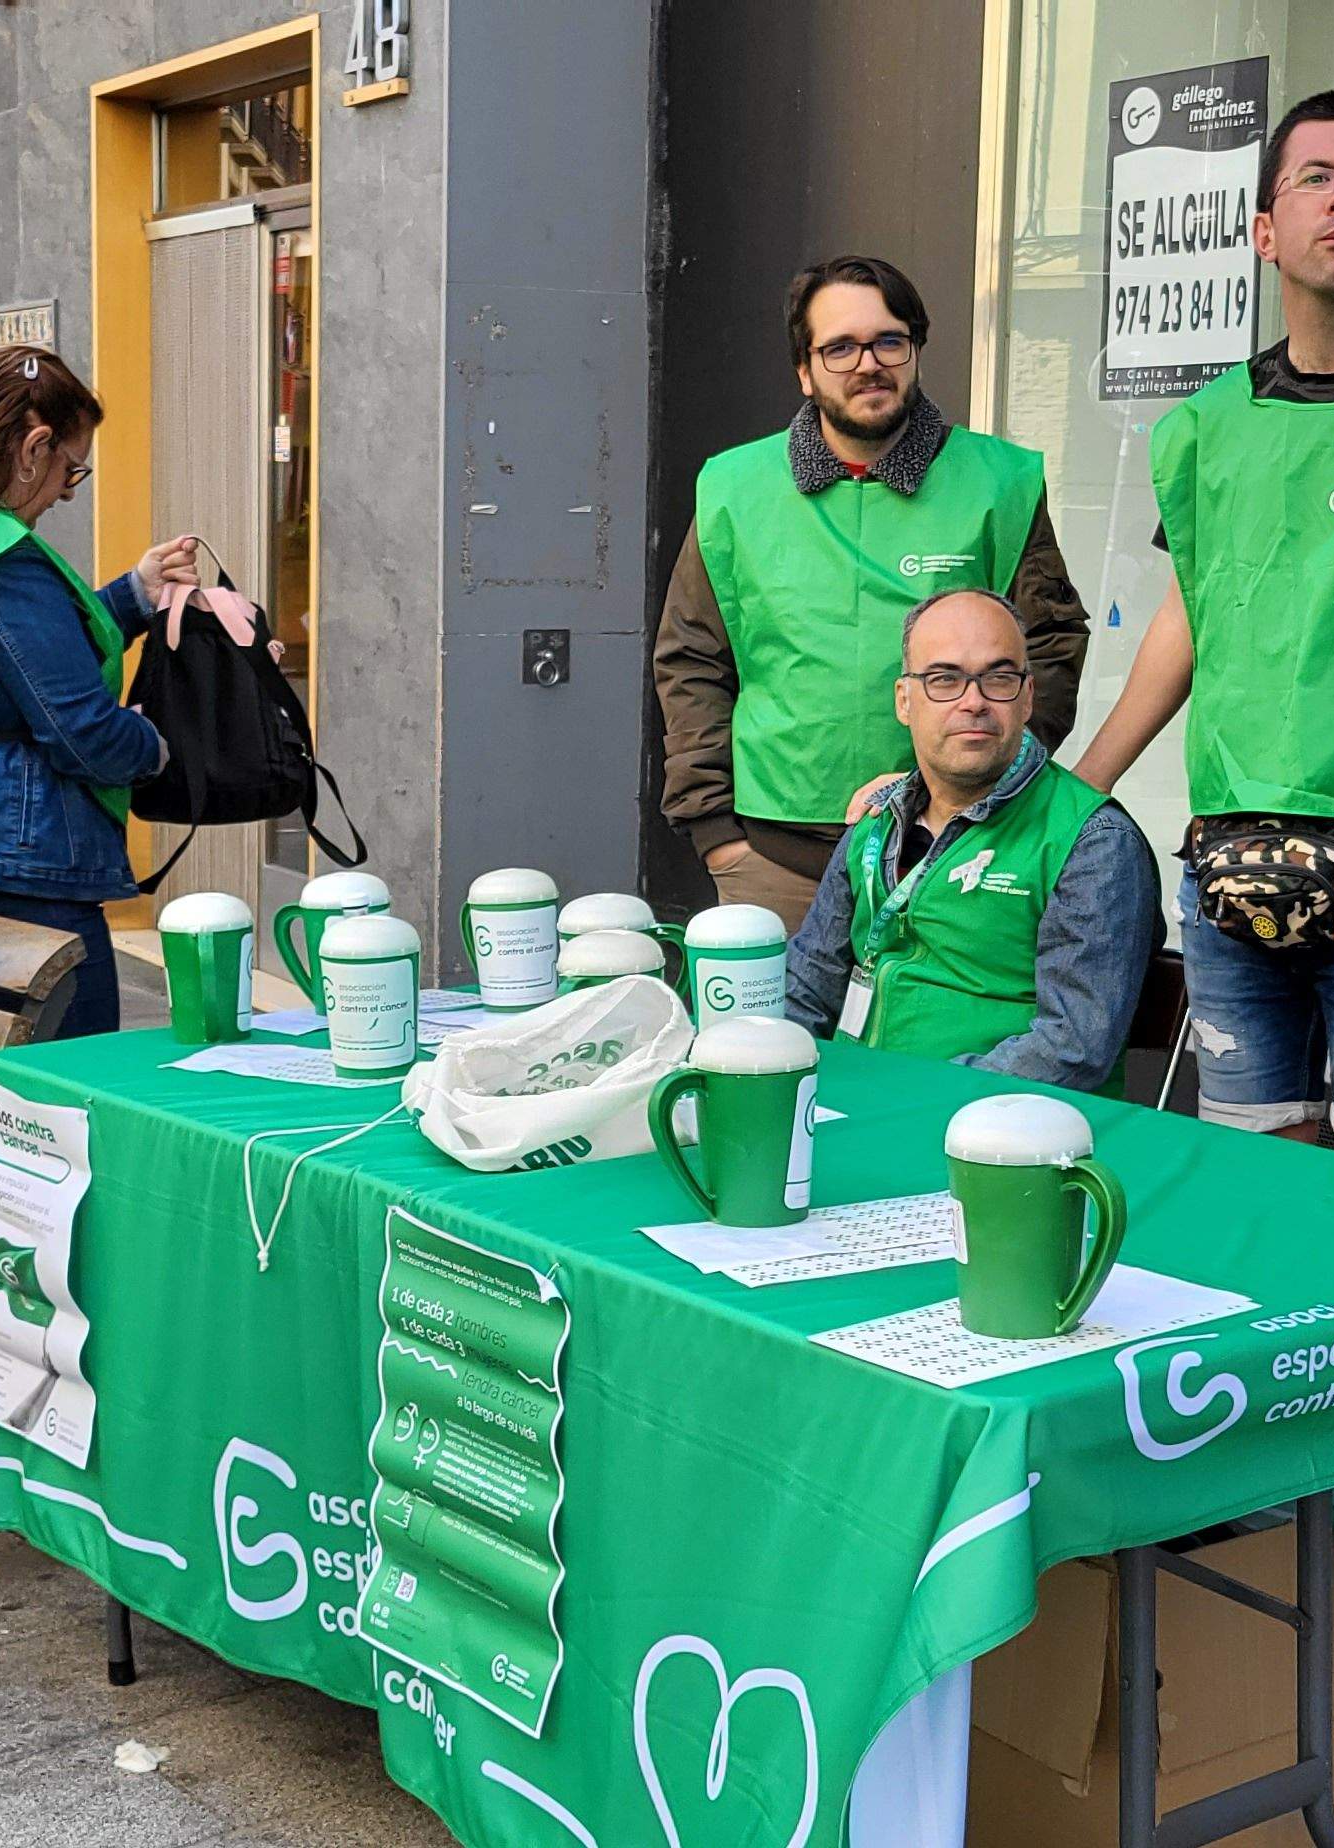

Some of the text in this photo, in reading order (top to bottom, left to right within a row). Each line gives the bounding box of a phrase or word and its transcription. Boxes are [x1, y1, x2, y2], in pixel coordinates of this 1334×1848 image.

[345, 0, 405, 88] 48
[1172, 85, 1223, 111] gállego
[1189, 99, 1255, 122] martínez
[1189, 117, 1254, 132] inmobiliaria
[1117, 187, 1248, 260] SE ALQUILA
[1116, 276, 1247, 336] 974 23 84 19
[498, 948, 524, 956] contra
[340, 1005, 368, 1013] contra
[370, 1005, 378, 1013] el
[742, 1000, 769, 1010] contra
[15, 1116, 57, 1144] contra
[392, 1286, 508, 1349] 1 de cada 2 hombres
[401, 1317, 409, 1331] 1
[408, 1318, 425, 1338] de
[426, 1328, 456, 1351] cada
[455, 1340, 466, 1358] 3
[456, 1396, 463, 1407] a
[464, 1396, 472, 1411] lo
[472, 1401, 494, 1423] largo
[494, 1413, 507, 1428] de
[507, 1420, 518, 1433] su
